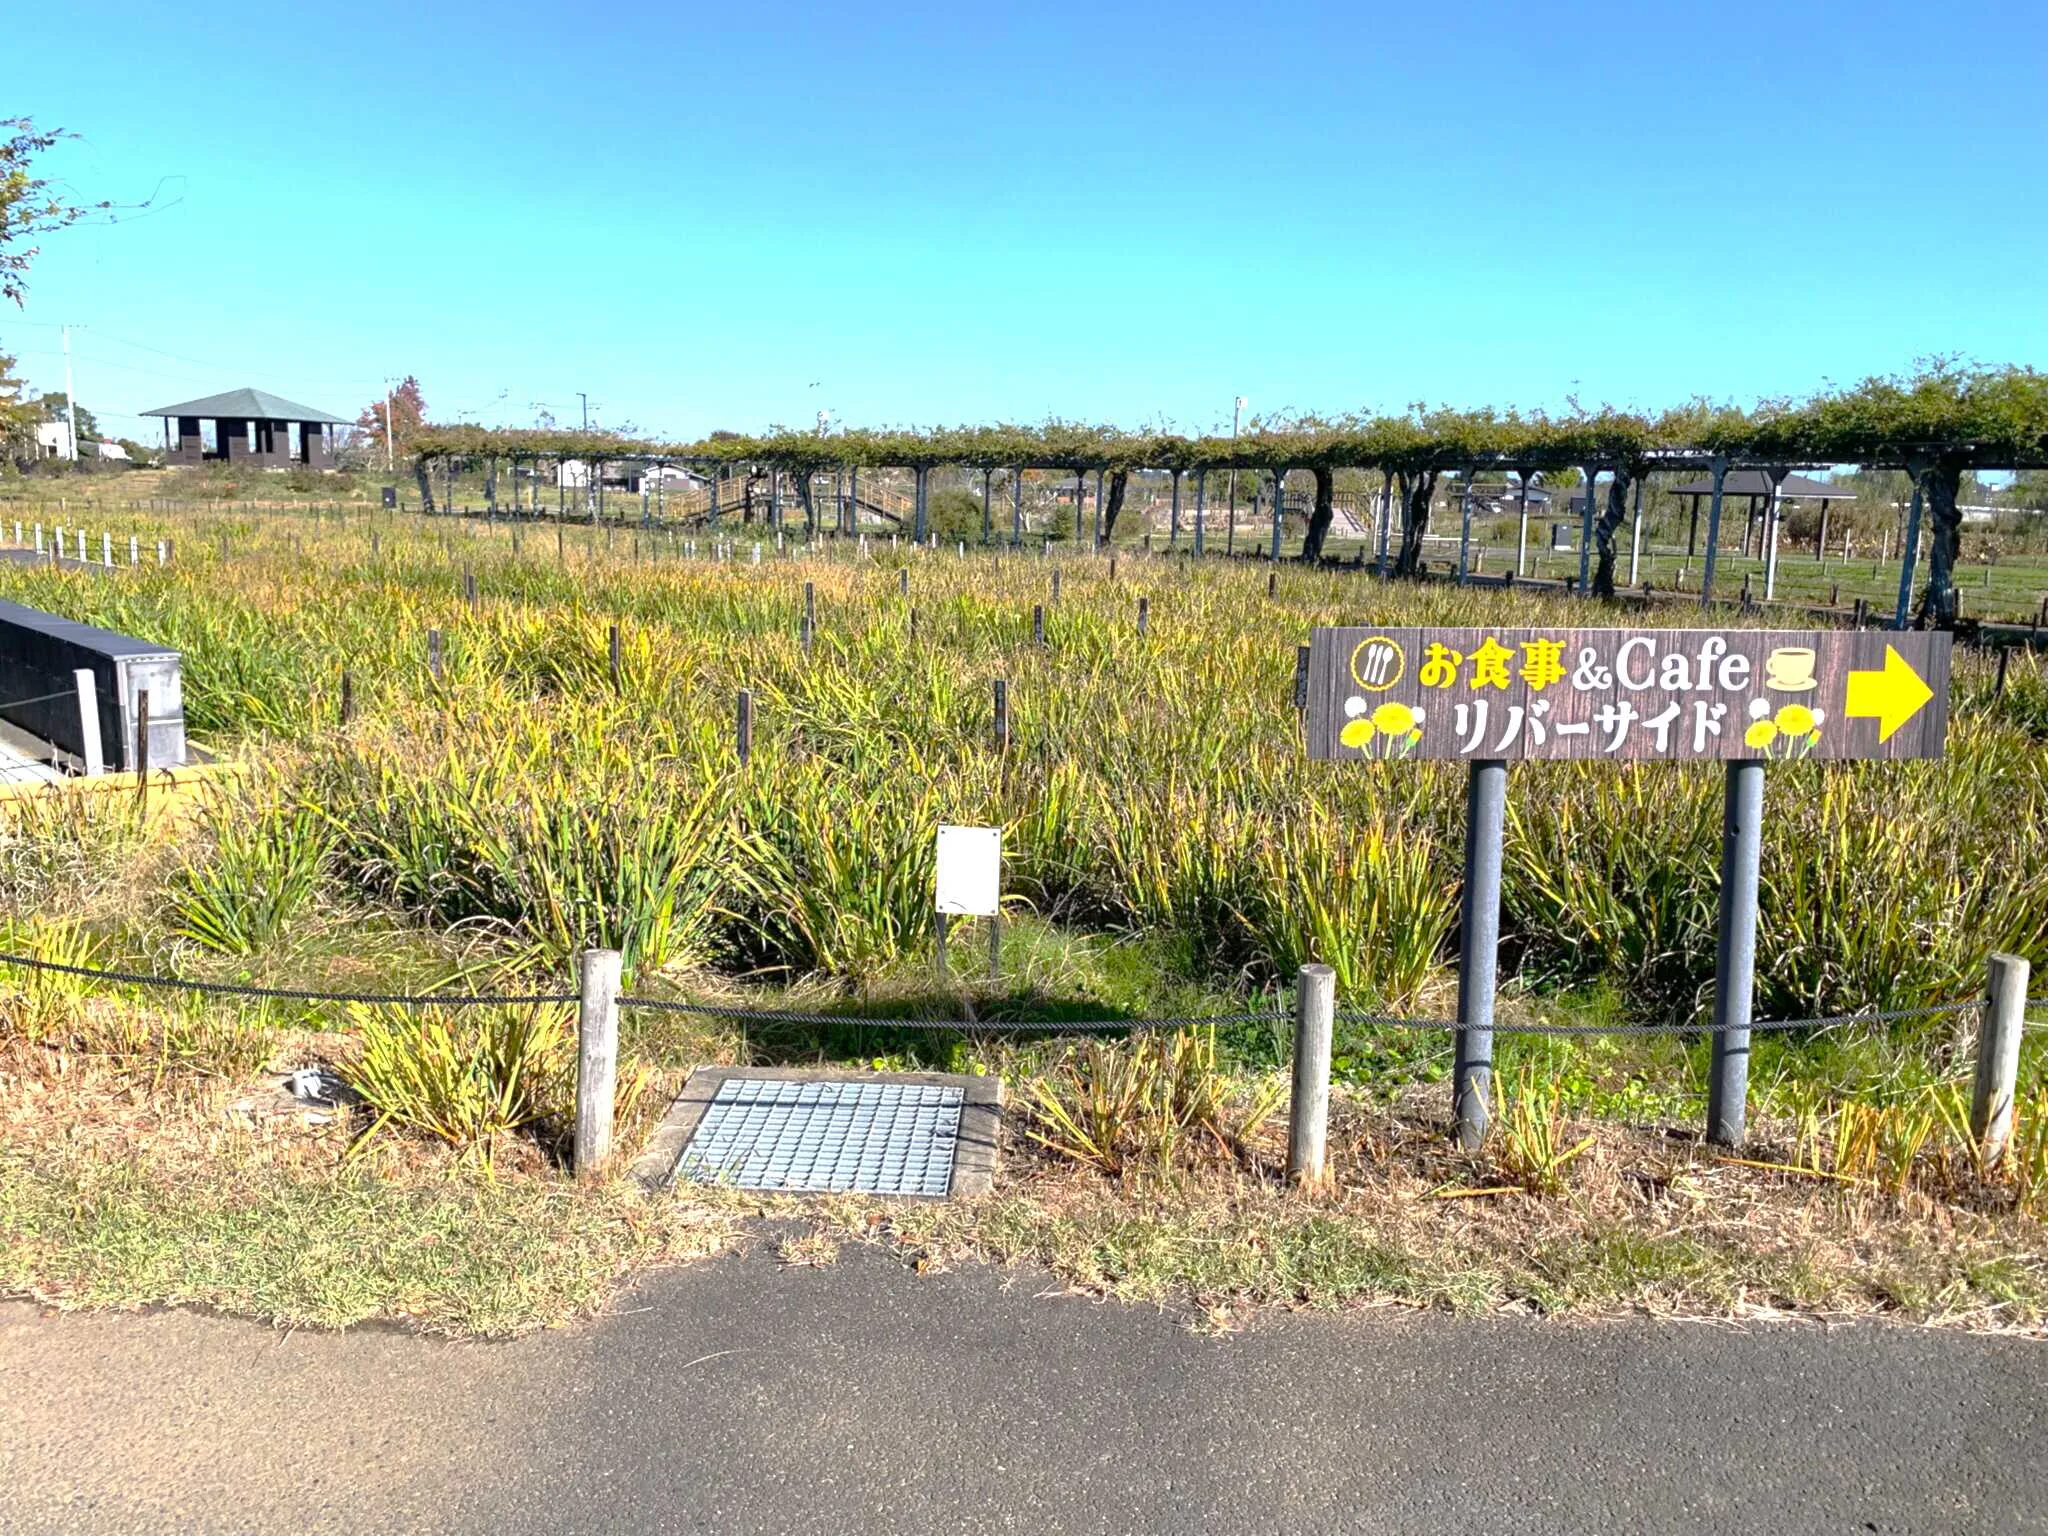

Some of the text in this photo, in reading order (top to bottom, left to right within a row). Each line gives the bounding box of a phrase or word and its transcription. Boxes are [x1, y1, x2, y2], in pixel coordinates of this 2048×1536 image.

[1455, 699, 1728, 754] リバーサイド
